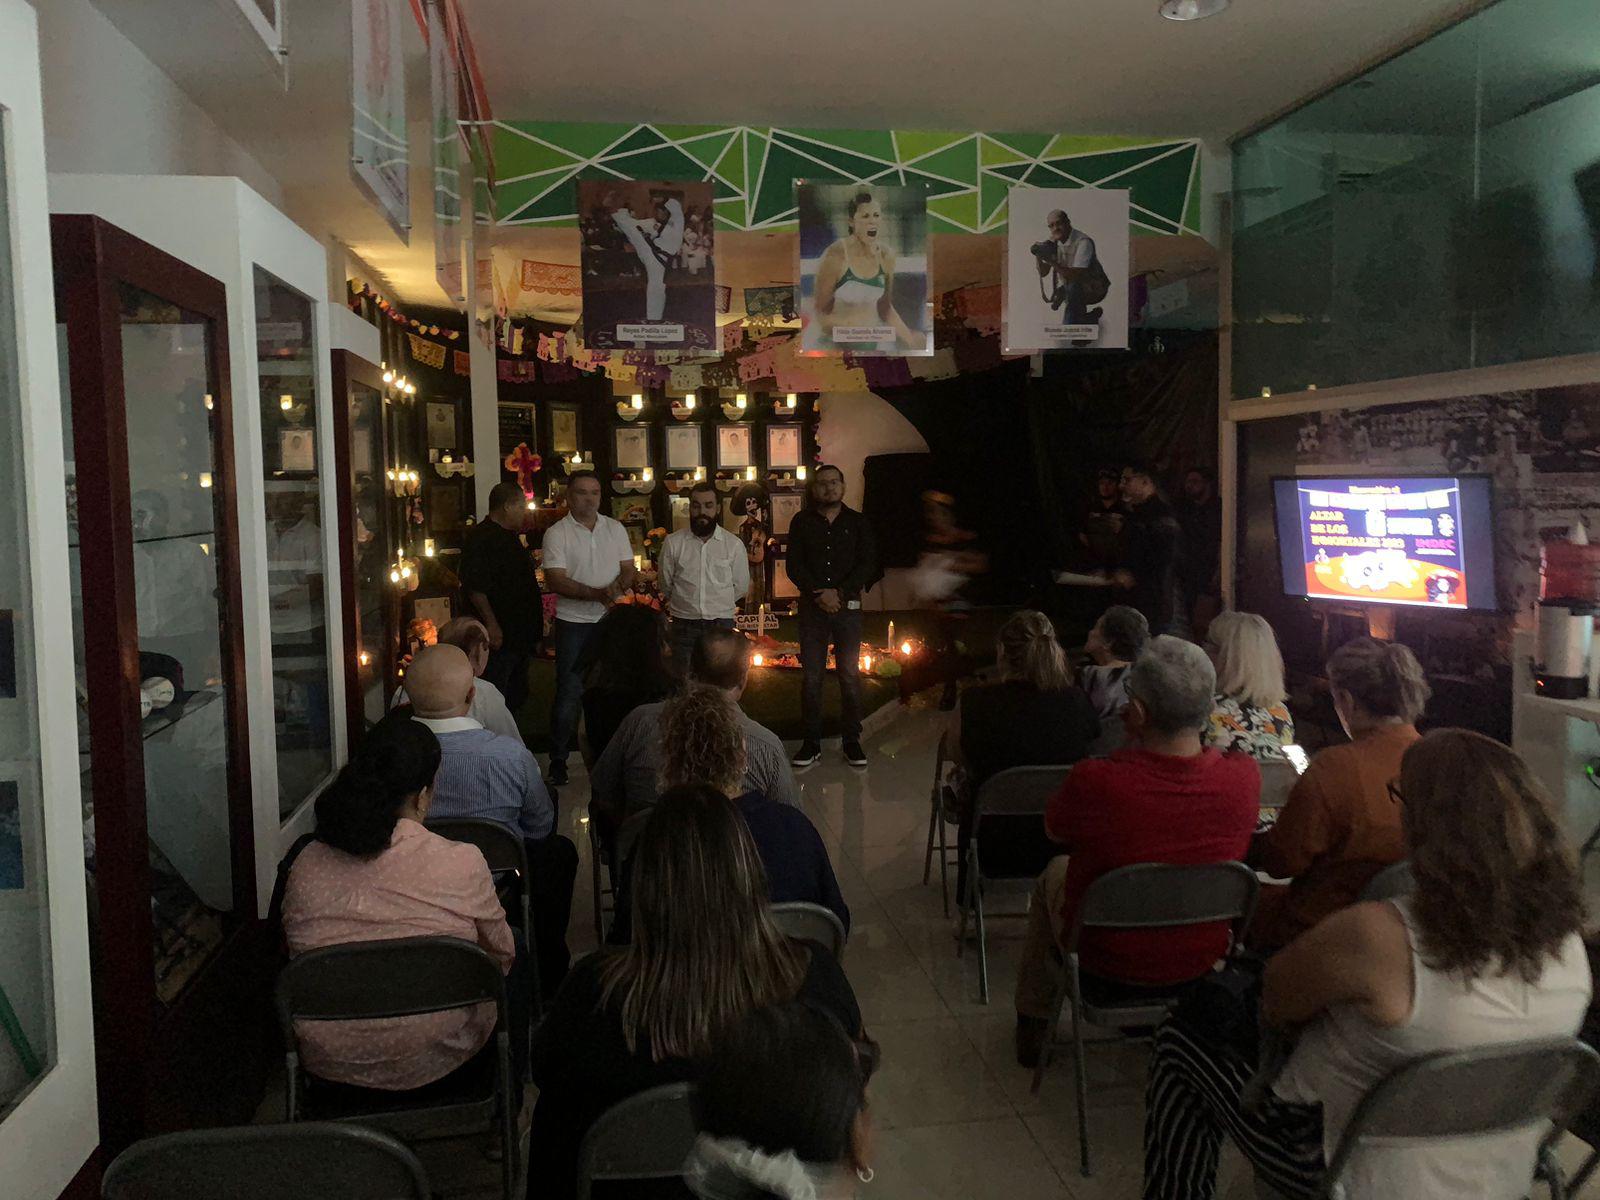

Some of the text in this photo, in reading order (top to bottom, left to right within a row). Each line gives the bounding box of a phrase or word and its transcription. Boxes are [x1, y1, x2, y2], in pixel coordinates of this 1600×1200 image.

[622, 327, 640, 335] Reyes
[1309, 510, 1344, 521] ALTAR
[1310, 523, 1349, 535] DE LOS
[1310, 535, 1381, 548] INMORTALES
[737, 615, 777, 623] CAPIAL
